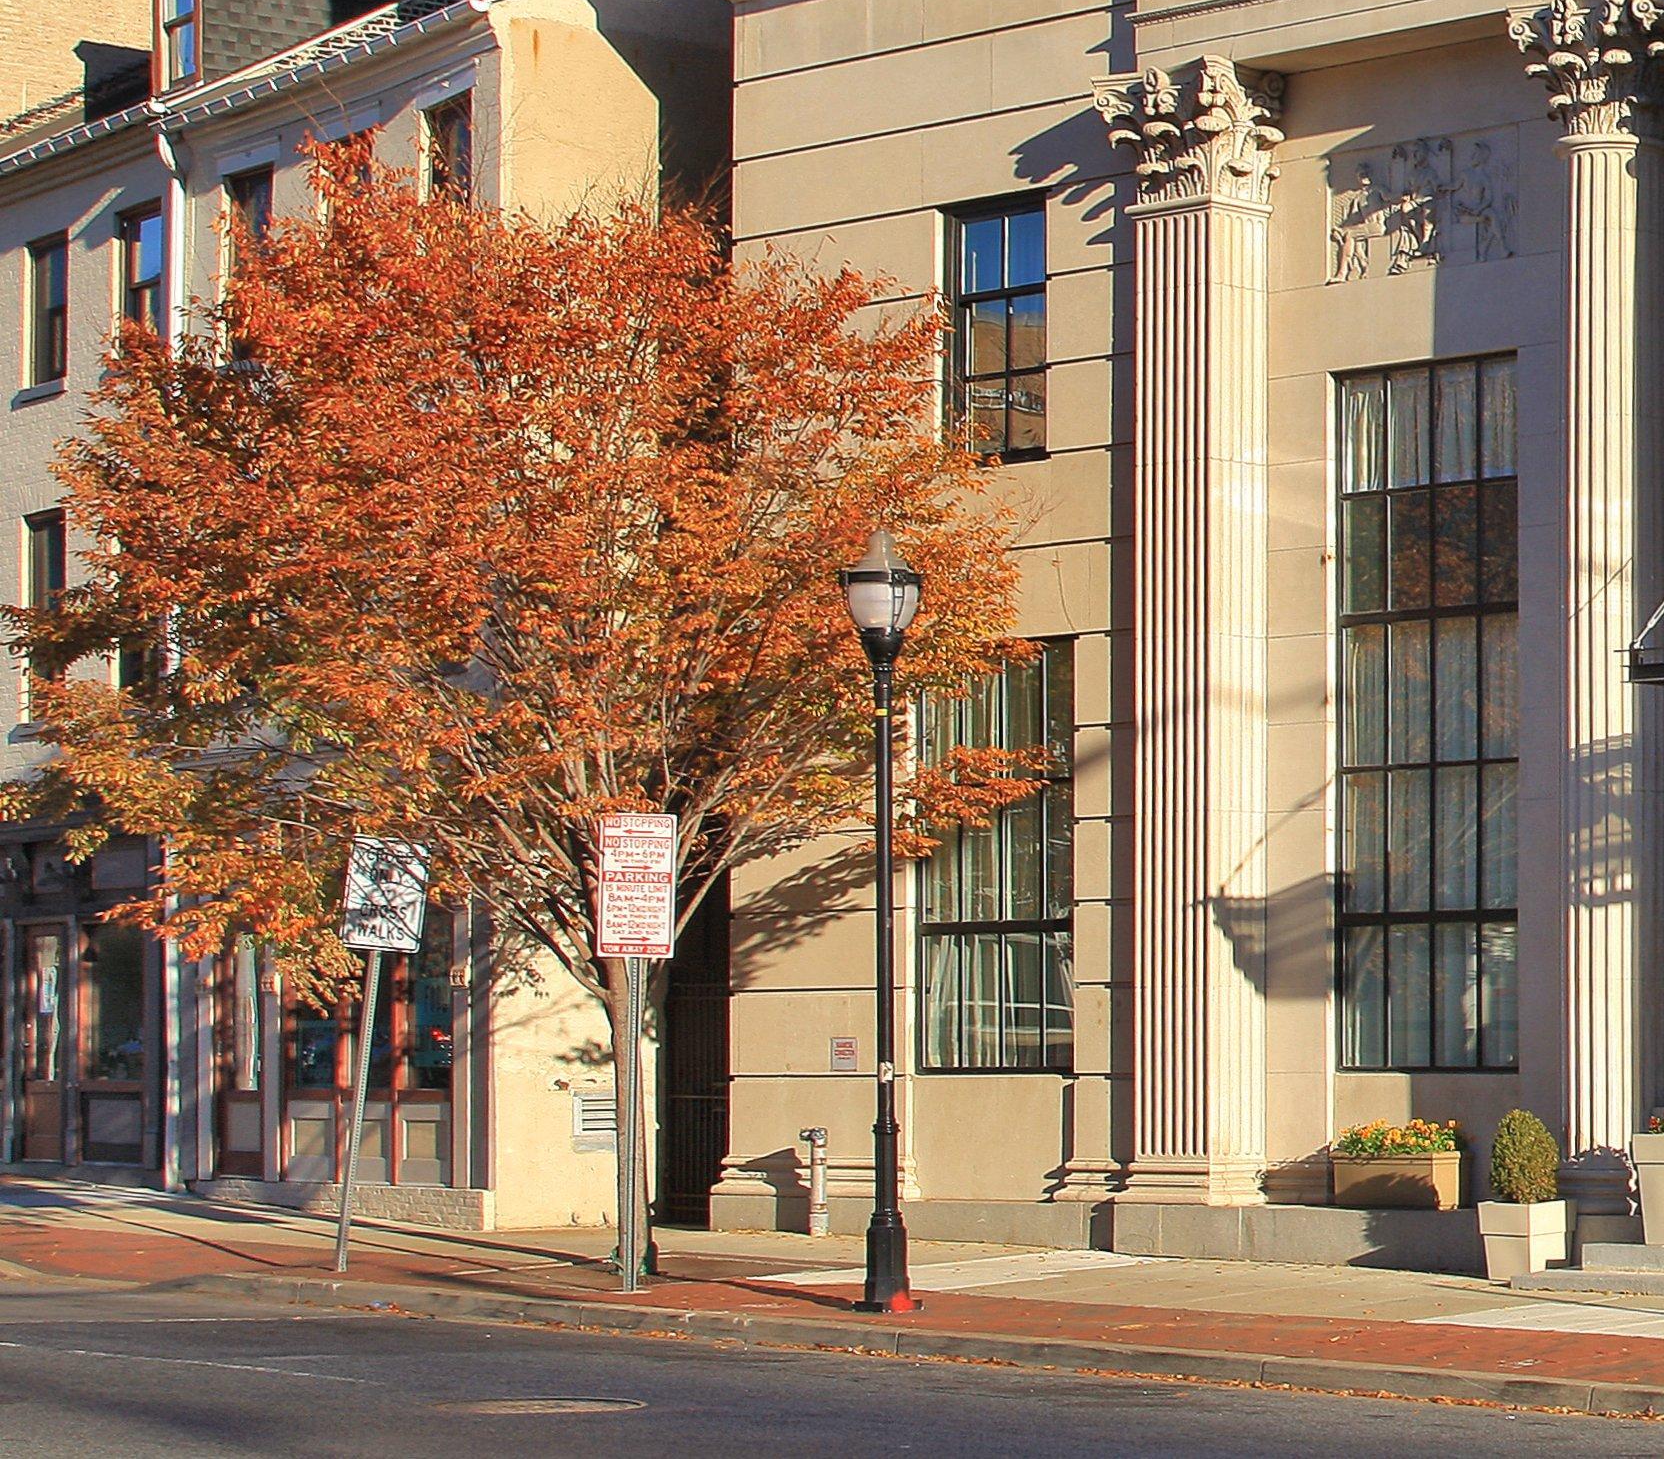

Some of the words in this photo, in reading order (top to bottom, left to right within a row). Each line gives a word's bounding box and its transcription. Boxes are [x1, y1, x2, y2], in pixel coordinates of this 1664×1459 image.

[604, 816, 620, 828] NO
[622, 818, 670, 829] STOPPING
[604, 836, 620, 847] NO
[622, 838, 670, 850] STOPPING
[611, 849, 666, 859] 4PM-6PM
[605, 871, 670, 883] PARKING
[616, 884, 646, 893] MINUTE
[648, 885, 668, 893] LIMIT
[608, 892, 666, 903] 8AM-4PM
[360, 903, 408, 920] CROSS
[357, 923, 405, 941] WALKS
[602, 944, 621, 953] TOW
[622, 945, 646, 954] AWAY
[647, 946, 668, 954] ZONE
